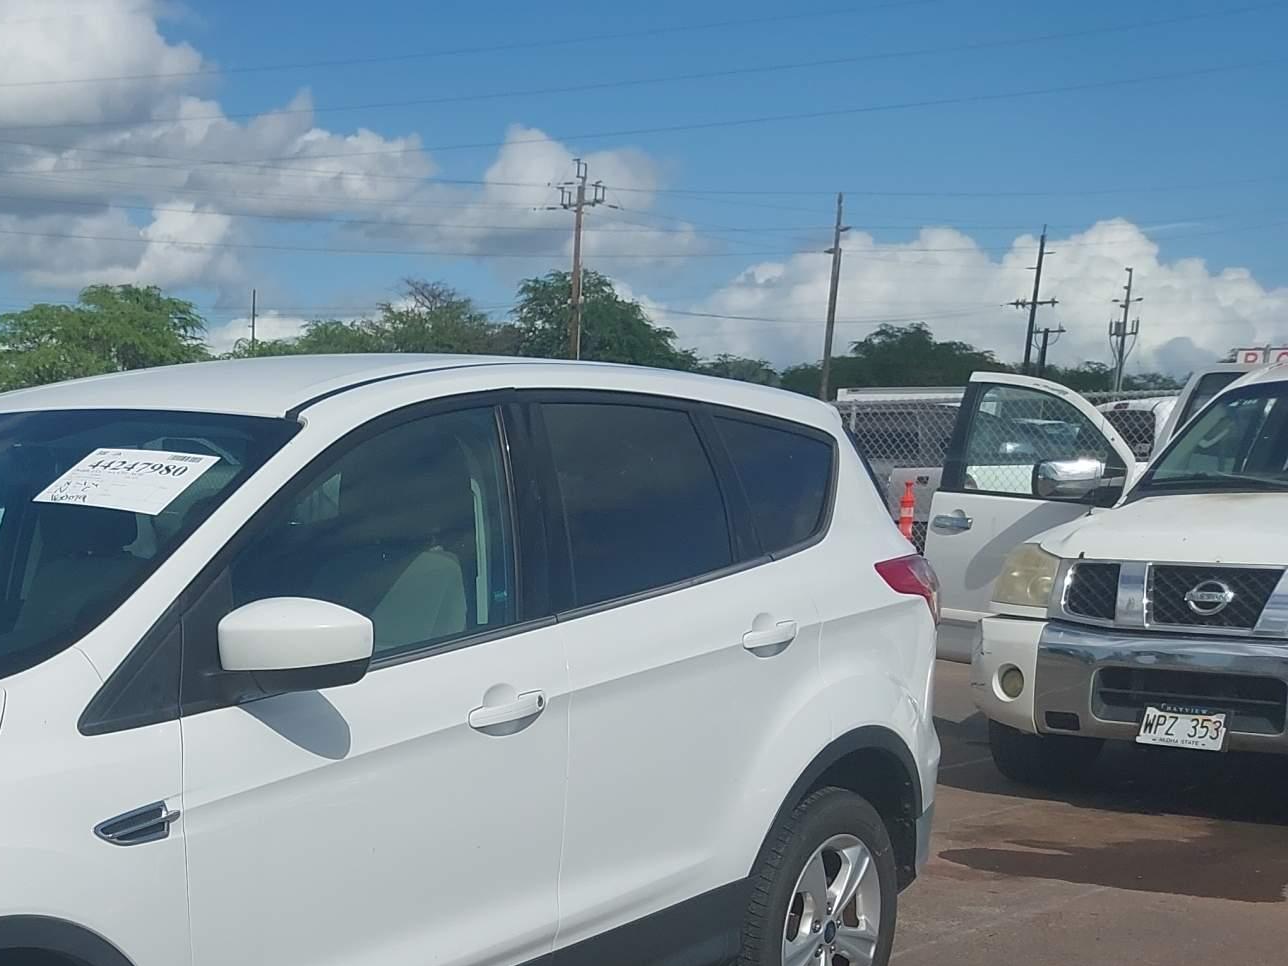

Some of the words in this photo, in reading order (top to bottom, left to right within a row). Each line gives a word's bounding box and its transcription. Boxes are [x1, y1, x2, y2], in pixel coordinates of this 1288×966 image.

[88, 459, 189, 477] 44247980
[1143, 714, 1179, 736] WPZ
[1187, 718, 1222, 740] 353
